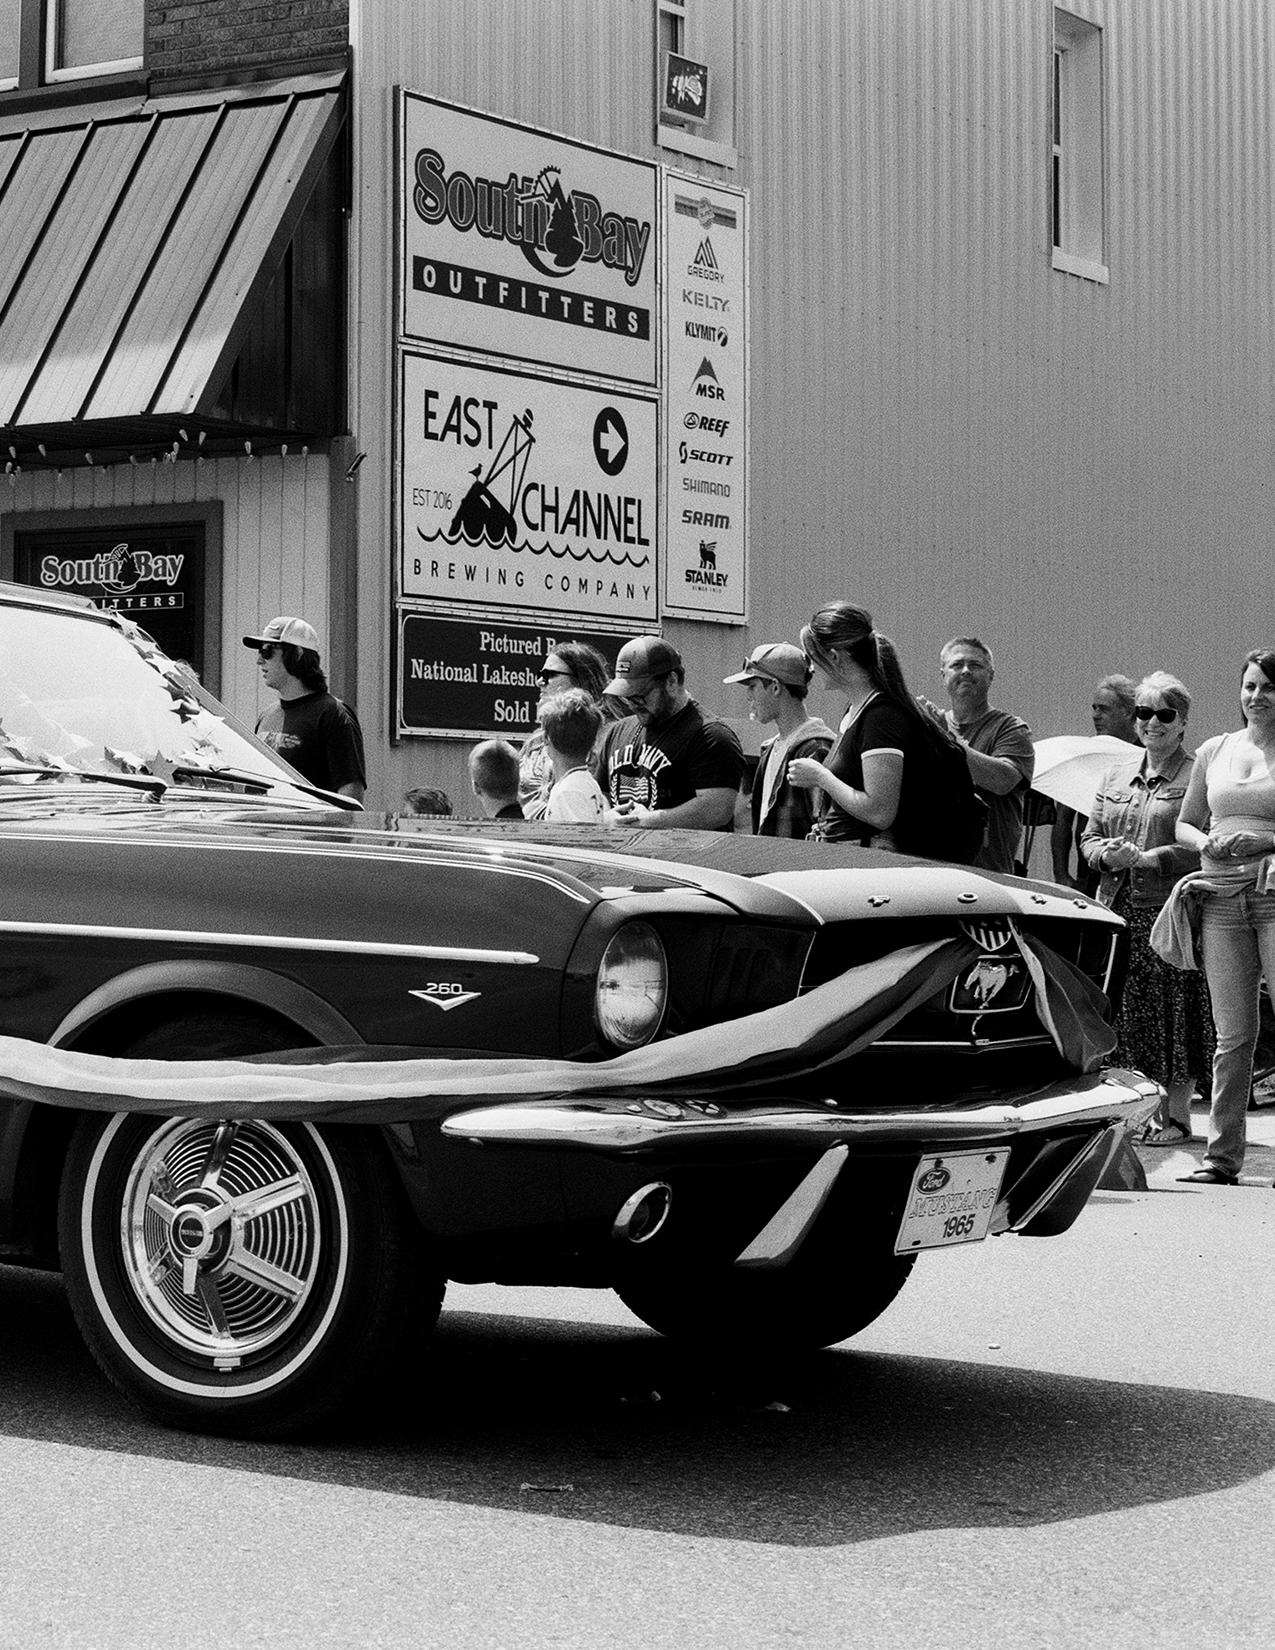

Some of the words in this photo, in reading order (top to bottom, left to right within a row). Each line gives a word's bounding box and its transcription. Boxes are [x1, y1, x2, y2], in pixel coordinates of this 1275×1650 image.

[413, 148, 550, 252] South
[571, 189, 651, 287] Bay
[687, 265, 725, 284] GREGORY
[423, 264, 639, 333] OUTFITTERS
[682, 288, 729, 312] KELTY
[685, 321, 717, 342] KLYMIT
[695, 383, 725, 401] MSR
[424, 389, 498, 450] EAST
[698, 416, 730, 438] REEF
[689, 449, 733, 466] SCOTT
[412, 487, 431, 507] EST
[433, 490, 453, 510] 2016
[682, 477, 730, 498] SHIMANO
[521, 482, 650, 547] CHANNEL
[682, 509, 730, 529] SRAM
[40, 552, 119, 586] South
[132, 551, 184, 586] Bay
[414, 558, 524, 587] BREWING
[545, 574, 651, 600] COMPANY
[685, 569, 728, 587] STANLEY
[101, 596, 176, 610] ITTERS
[479, 631, 542, 656] Pictured
[410, 658, 477, 682] National
[482, 664, 541, 687] Lakesh
[494, 699, 531, 723] Sold
[426, 982, 463, 994] 260
[922, 1171, 946, 1189] Ford
[942, 1213, 976, 1238] 1965
